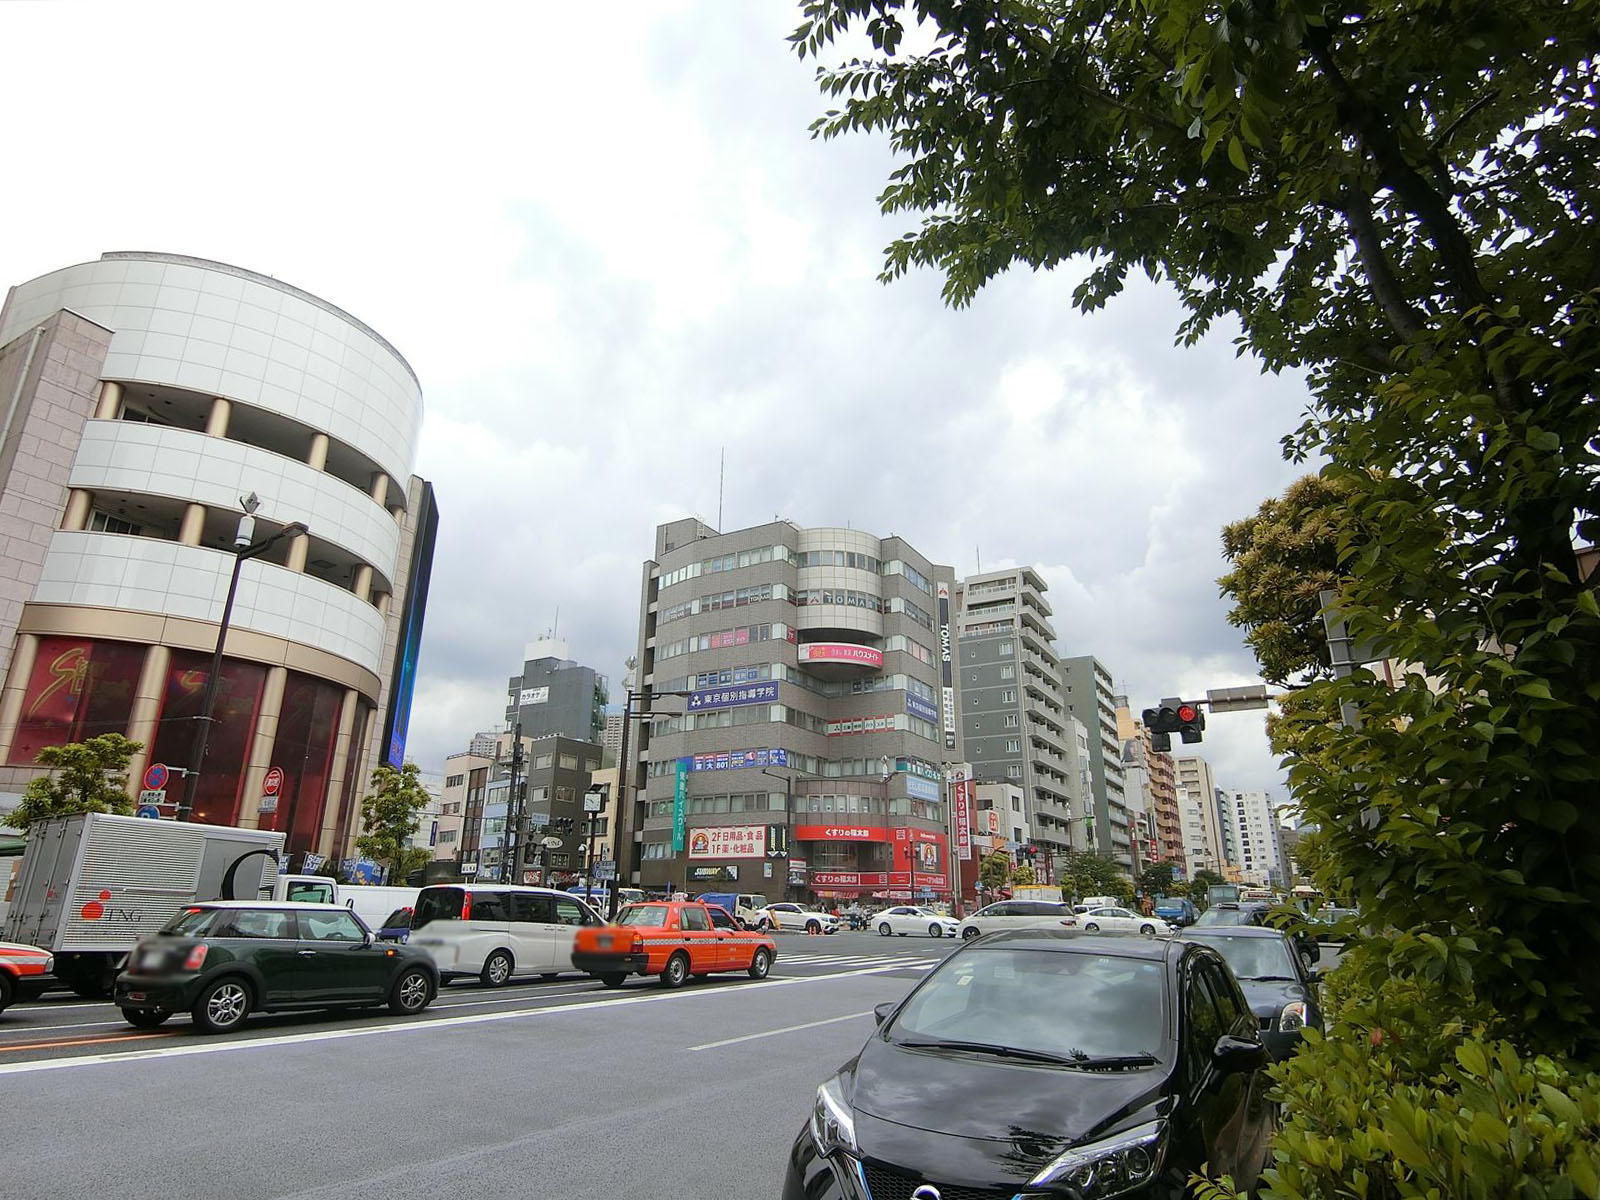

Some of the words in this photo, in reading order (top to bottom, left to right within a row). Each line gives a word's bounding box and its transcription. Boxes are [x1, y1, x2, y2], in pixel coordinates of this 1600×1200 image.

[826, 595, 875, 610] TOMAS
[940, 623, 951, 662] TOMAS
[704, 686, 775, 704] 東京個別指導学院
[694, 867, 721, 876] SUBWAY
